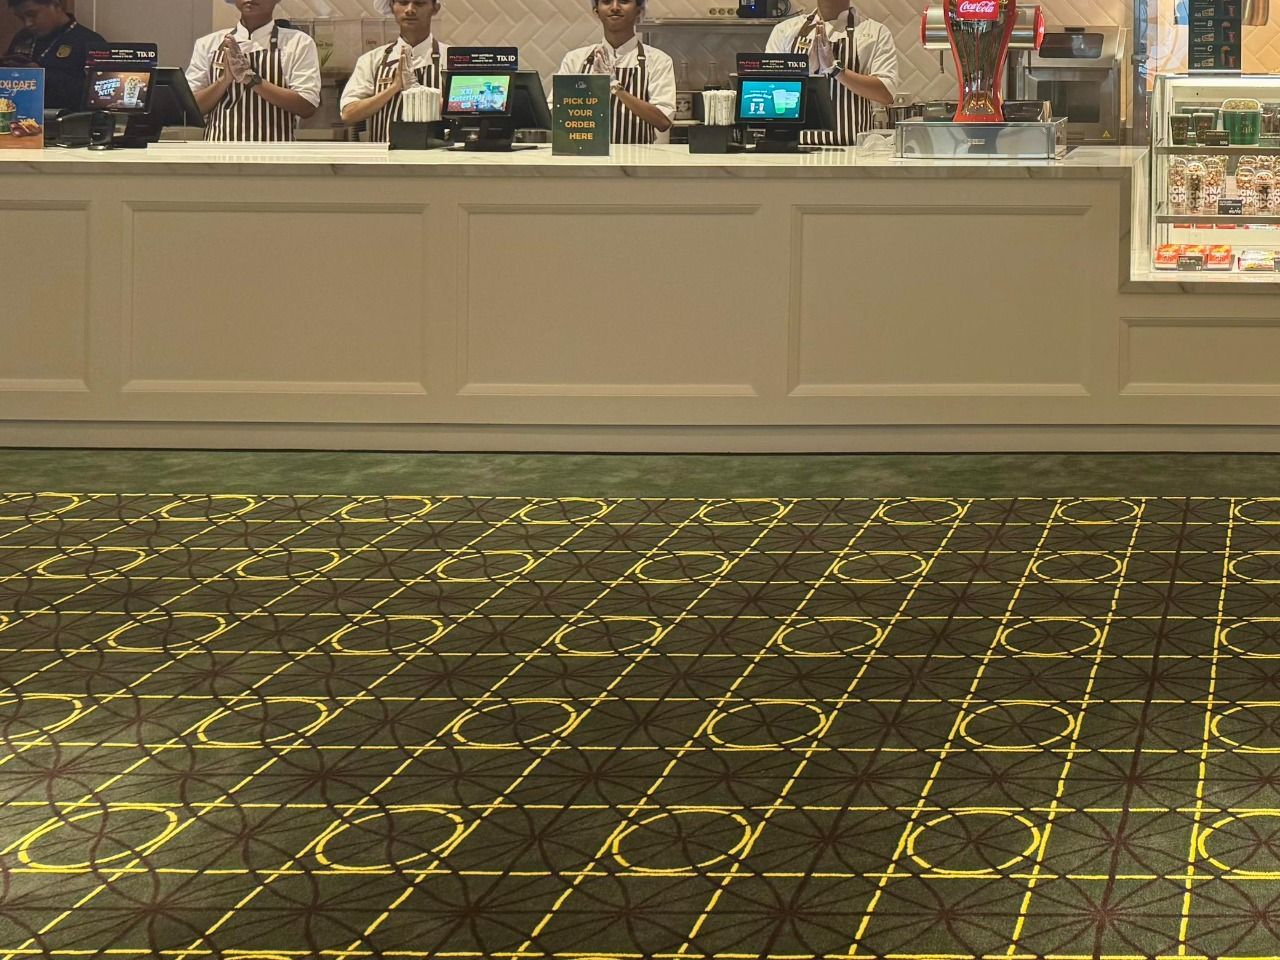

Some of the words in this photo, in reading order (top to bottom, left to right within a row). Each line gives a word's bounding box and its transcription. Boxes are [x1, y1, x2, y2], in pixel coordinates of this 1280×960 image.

[959, 0, 996, 13] Coca-Cola
[94, 81, 120, 90] TOFFEE
[98, 88, 115, 96] NUT
[563, 97, 583, 105] PICK
[585, 97, 598, 105] UP
[568, 109, 593, 117] YOUR
[564, 120, 596, 128] ORDER
[569, 132, 593, 140] HERE
